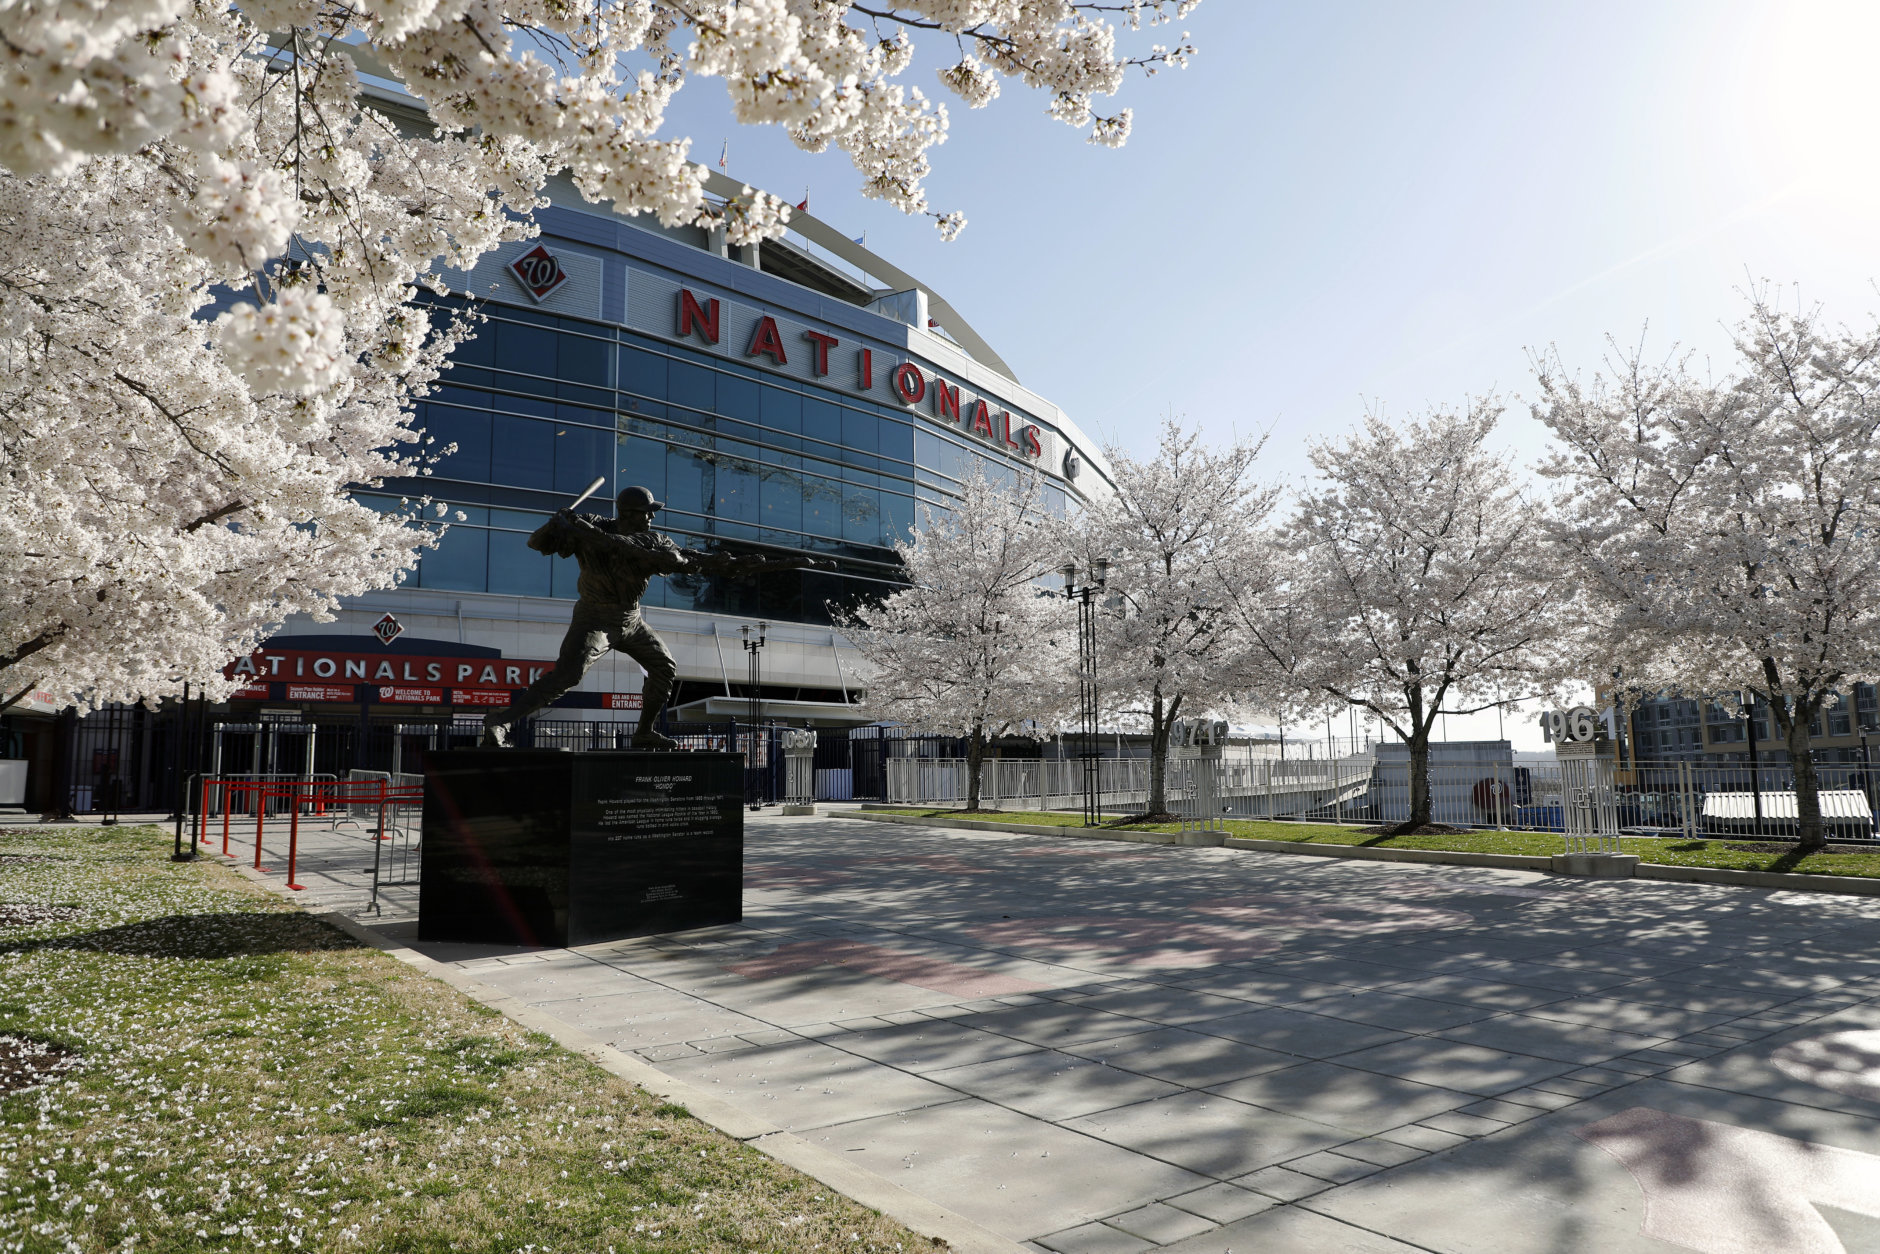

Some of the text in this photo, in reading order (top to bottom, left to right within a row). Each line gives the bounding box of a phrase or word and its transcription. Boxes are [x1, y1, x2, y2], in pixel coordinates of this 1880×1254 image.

[677, 289, 1042, 460] NATIONALS
[217, 655, 441, 682] ATIONALS
[290, 692, 325, 700] ENTRANCE
[1539, 706, 1617, 743] 1961
